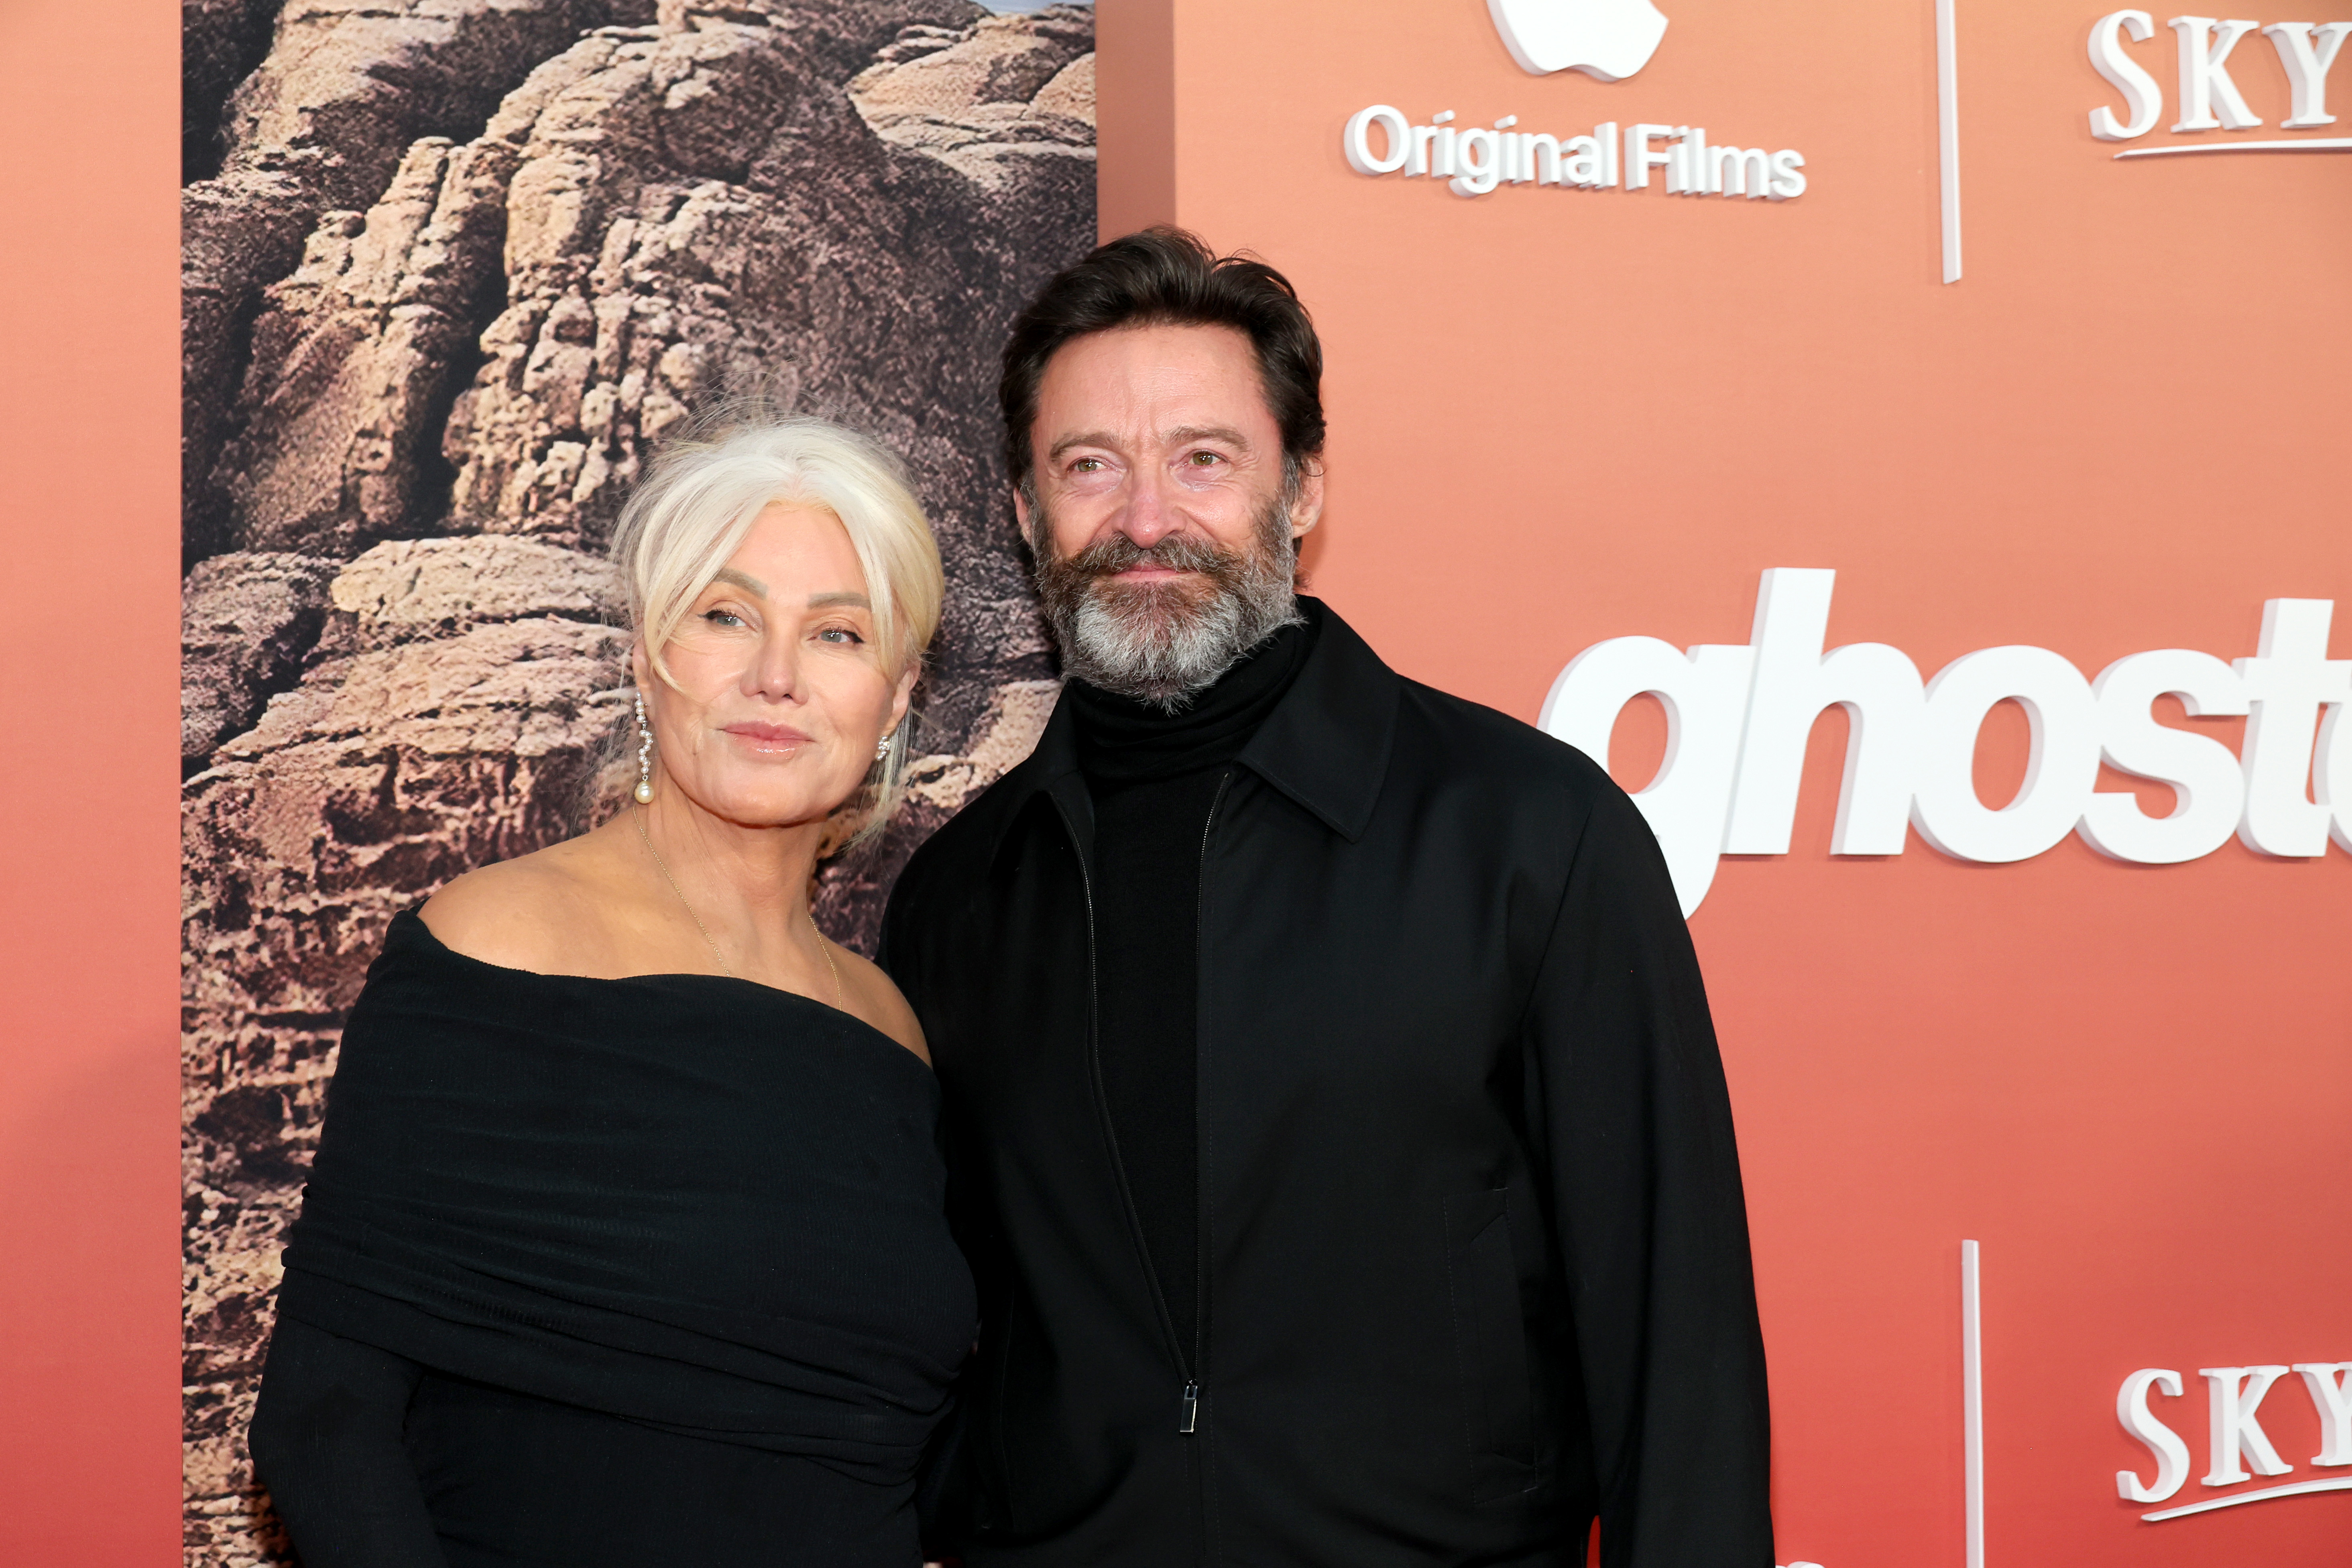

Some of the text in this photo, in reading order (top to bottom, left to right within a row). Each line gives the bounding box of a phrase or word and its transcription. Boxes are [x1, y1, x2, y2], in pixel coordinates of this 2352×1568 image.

[2087, 9, 2352, 140] SKY
[1344, 104, 1807, 200] Original Films
[1536, 567, 2352, 920] ghost
[2116, 1361, 2352, 1504] SKY
